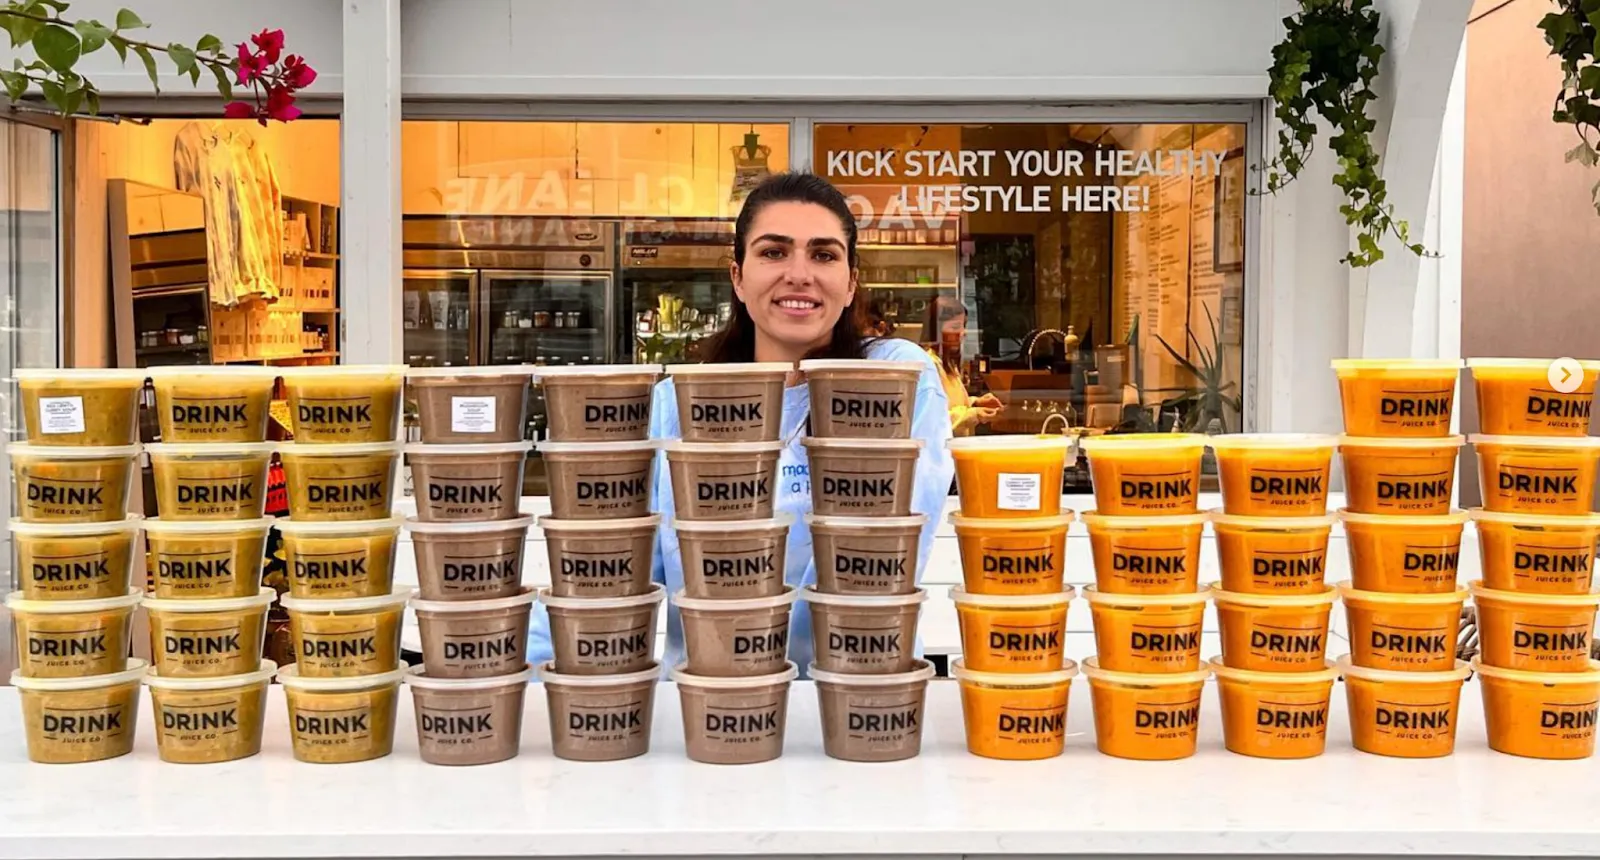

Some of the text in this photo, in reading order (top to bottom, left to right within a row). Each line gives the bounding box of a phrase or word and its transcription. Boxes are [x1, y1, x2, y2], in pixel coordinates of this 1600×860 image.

[827, 149, 1228, 177] KICK START YOUR HEALTHY
[900, 185, 1150, 213] LIFESTYLE HERE!
[172, 403, 247, 424] DRINK
[298, 404, 370, 424] DRINK
[584, 403, 651, 424] DRINK
[691, 402, 762, 423] DRINK
[831, 397, 901, 418] DRINK
[1381, 398, 1449, 417] DRINK
[1527, 396, 1591, 418] DRINK
[27, 483, 102, 505] DRINK
[177, 481, 252, 504] DRINK
[307, 481, 381, 503] DRINK
[429, 483, 501, 504] DRINK
[576, 479, 646, 501] DRINK
[697, 479, 768, 501] DRINK
[823, 477, 893, 497] DRINK
[1121, 480, 1192, 499] DRINK
[1251, 476, 1322, 495] DRINK
[1377, 480, 1448, 499] DRINK
[1499, 472, 1577, 494] DRINK
[197, 505, 220, 514] JUICE
[597, 502, 619, 510] JUICE
[33, 559, 109, 582] DRINK
[159, 558, 230, 579] DRINK
[294, 557, 365, 579] DRINK
[443, 558, 515, 582] DRINK
[561, 557, 632, 578] DRINK
[702, 553, 774, 578] DRINK
[835, 554, 906, 577] DRINK
[983, 555, 1054, 574] DRINK
[1113, 553, 1185, 574] DRINK
[1253, 558, 1322, 577] DRINK
[1514, 551, 1589, 572] DRINK
[29, 634, 105, 657] DRINK
[165, 633, 240, 655] DRINK
[303, 636, 375, 659] DRINK
[444, 634, 516, 660] DRINK
[577, 631, 647, 657] DRINK
[829, 632, 899, 654] DRINK
[990, 632, 1059, 651] DRINK
[1131, 632, 1198, 651] DRINK
[1252, 631, 1320, 653] DRINK
[1372, 631, 1446, 653] DRINK
[1514, 630, 1587, 651] DRINK
[43, 711, 120, 734] DRINK
[163, 708, 236, 731] DRINK
[296, 713, 366, 735] DRINK
[421, 713, 492, 735] DRINK
[569, 708, 640, 732] DRINK
[706, 710, 776, 733] DRINK
[848, 707, 917, 732] DRINK
[999, 714, 1065, 733] DRINK
[1136, 709, 1199, 729] DRINK
[1257, 708, 1325, 728] DRINK
[1376, 708, 1449, 729] DRINK
